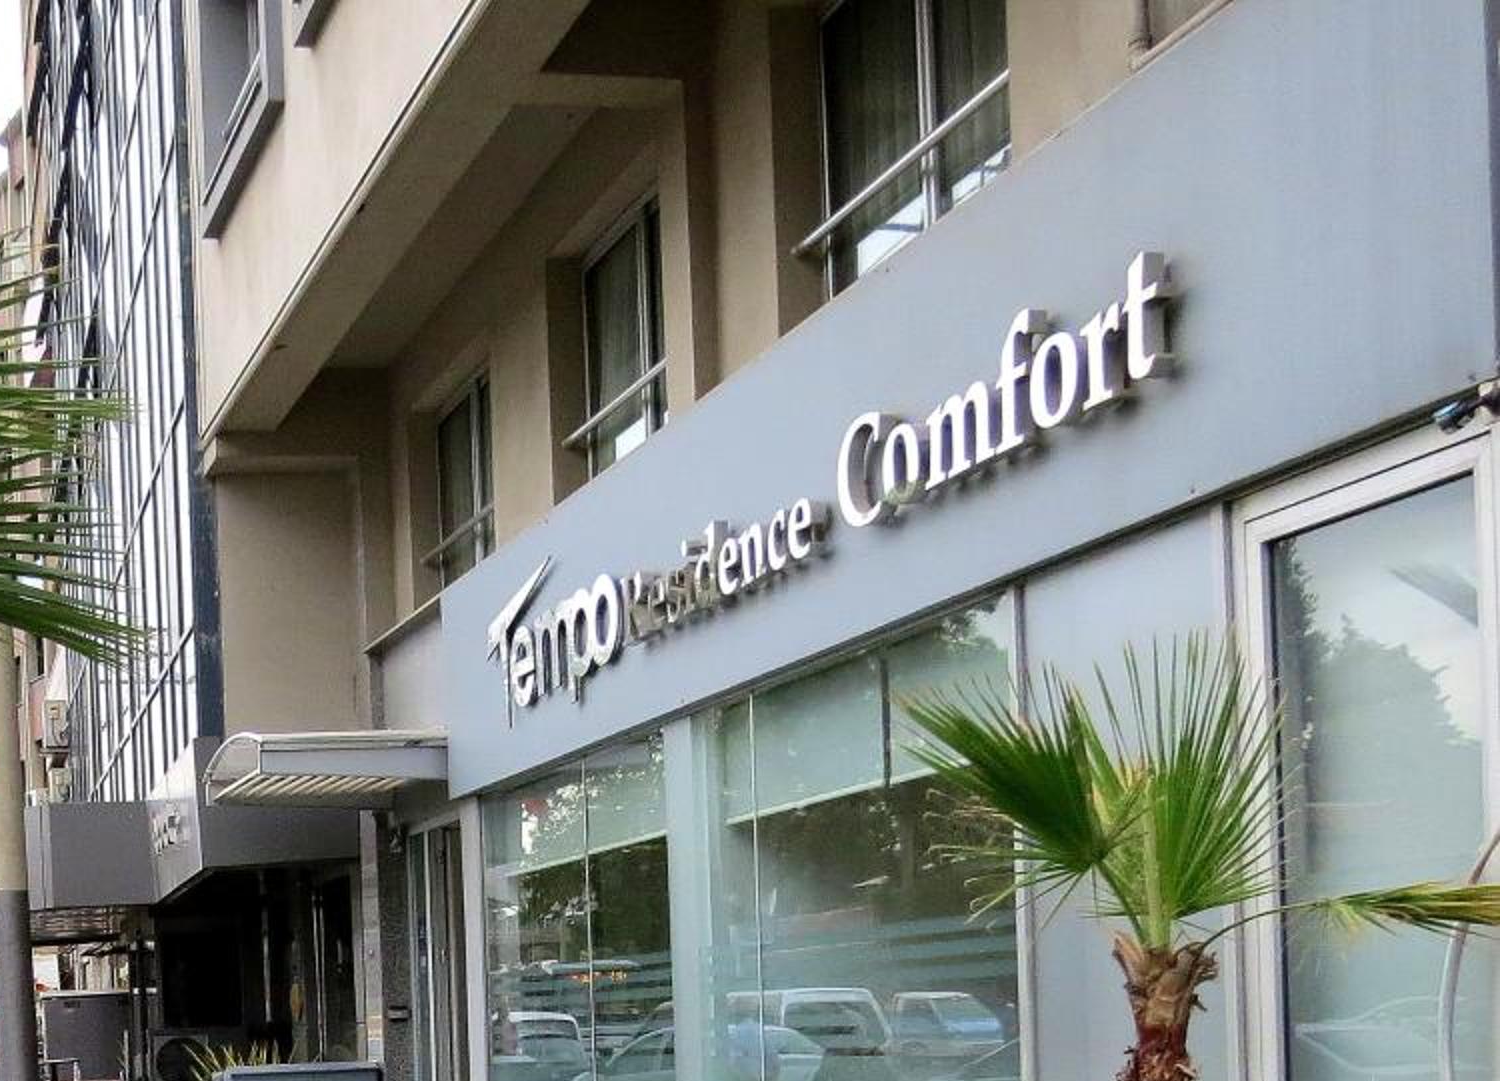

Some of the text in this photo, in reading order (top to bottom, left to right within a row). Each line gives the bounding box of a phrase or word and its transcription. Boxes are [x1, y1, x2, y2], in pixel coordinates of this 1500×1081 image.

[487, 250, 1160, 728] Tempo Residence Comfort
